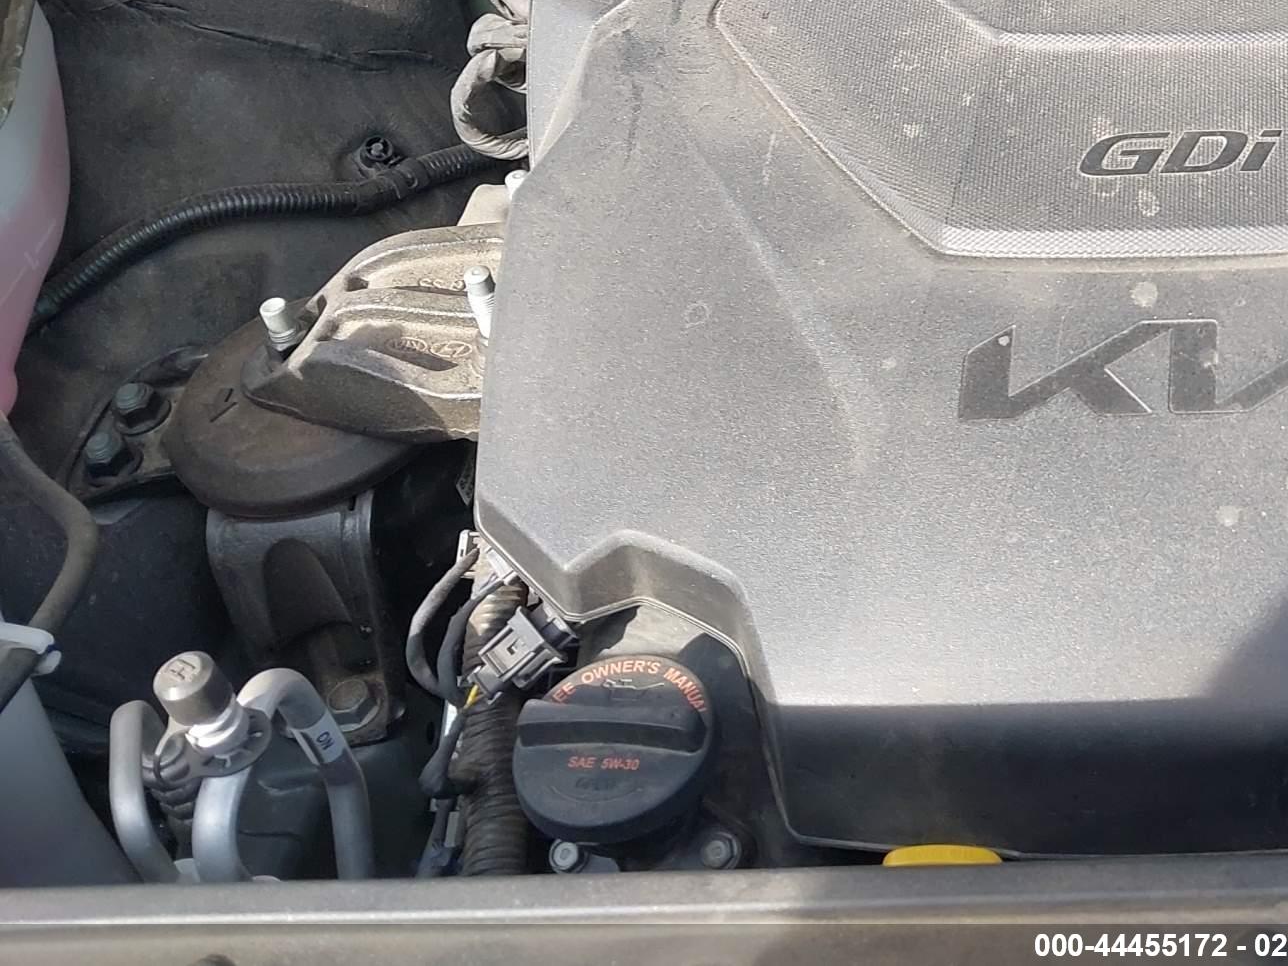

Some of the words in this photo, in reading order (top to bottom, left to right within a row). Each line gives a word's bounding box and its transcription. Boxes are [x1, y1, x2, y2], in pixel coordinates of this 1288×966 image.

[1080, 129, 1282, 176] GDi
[581, 660, 660, 684] OWNER'S
[567, 756, 596, 769] SAE
[600, 757, 640, 771] 5W-30
